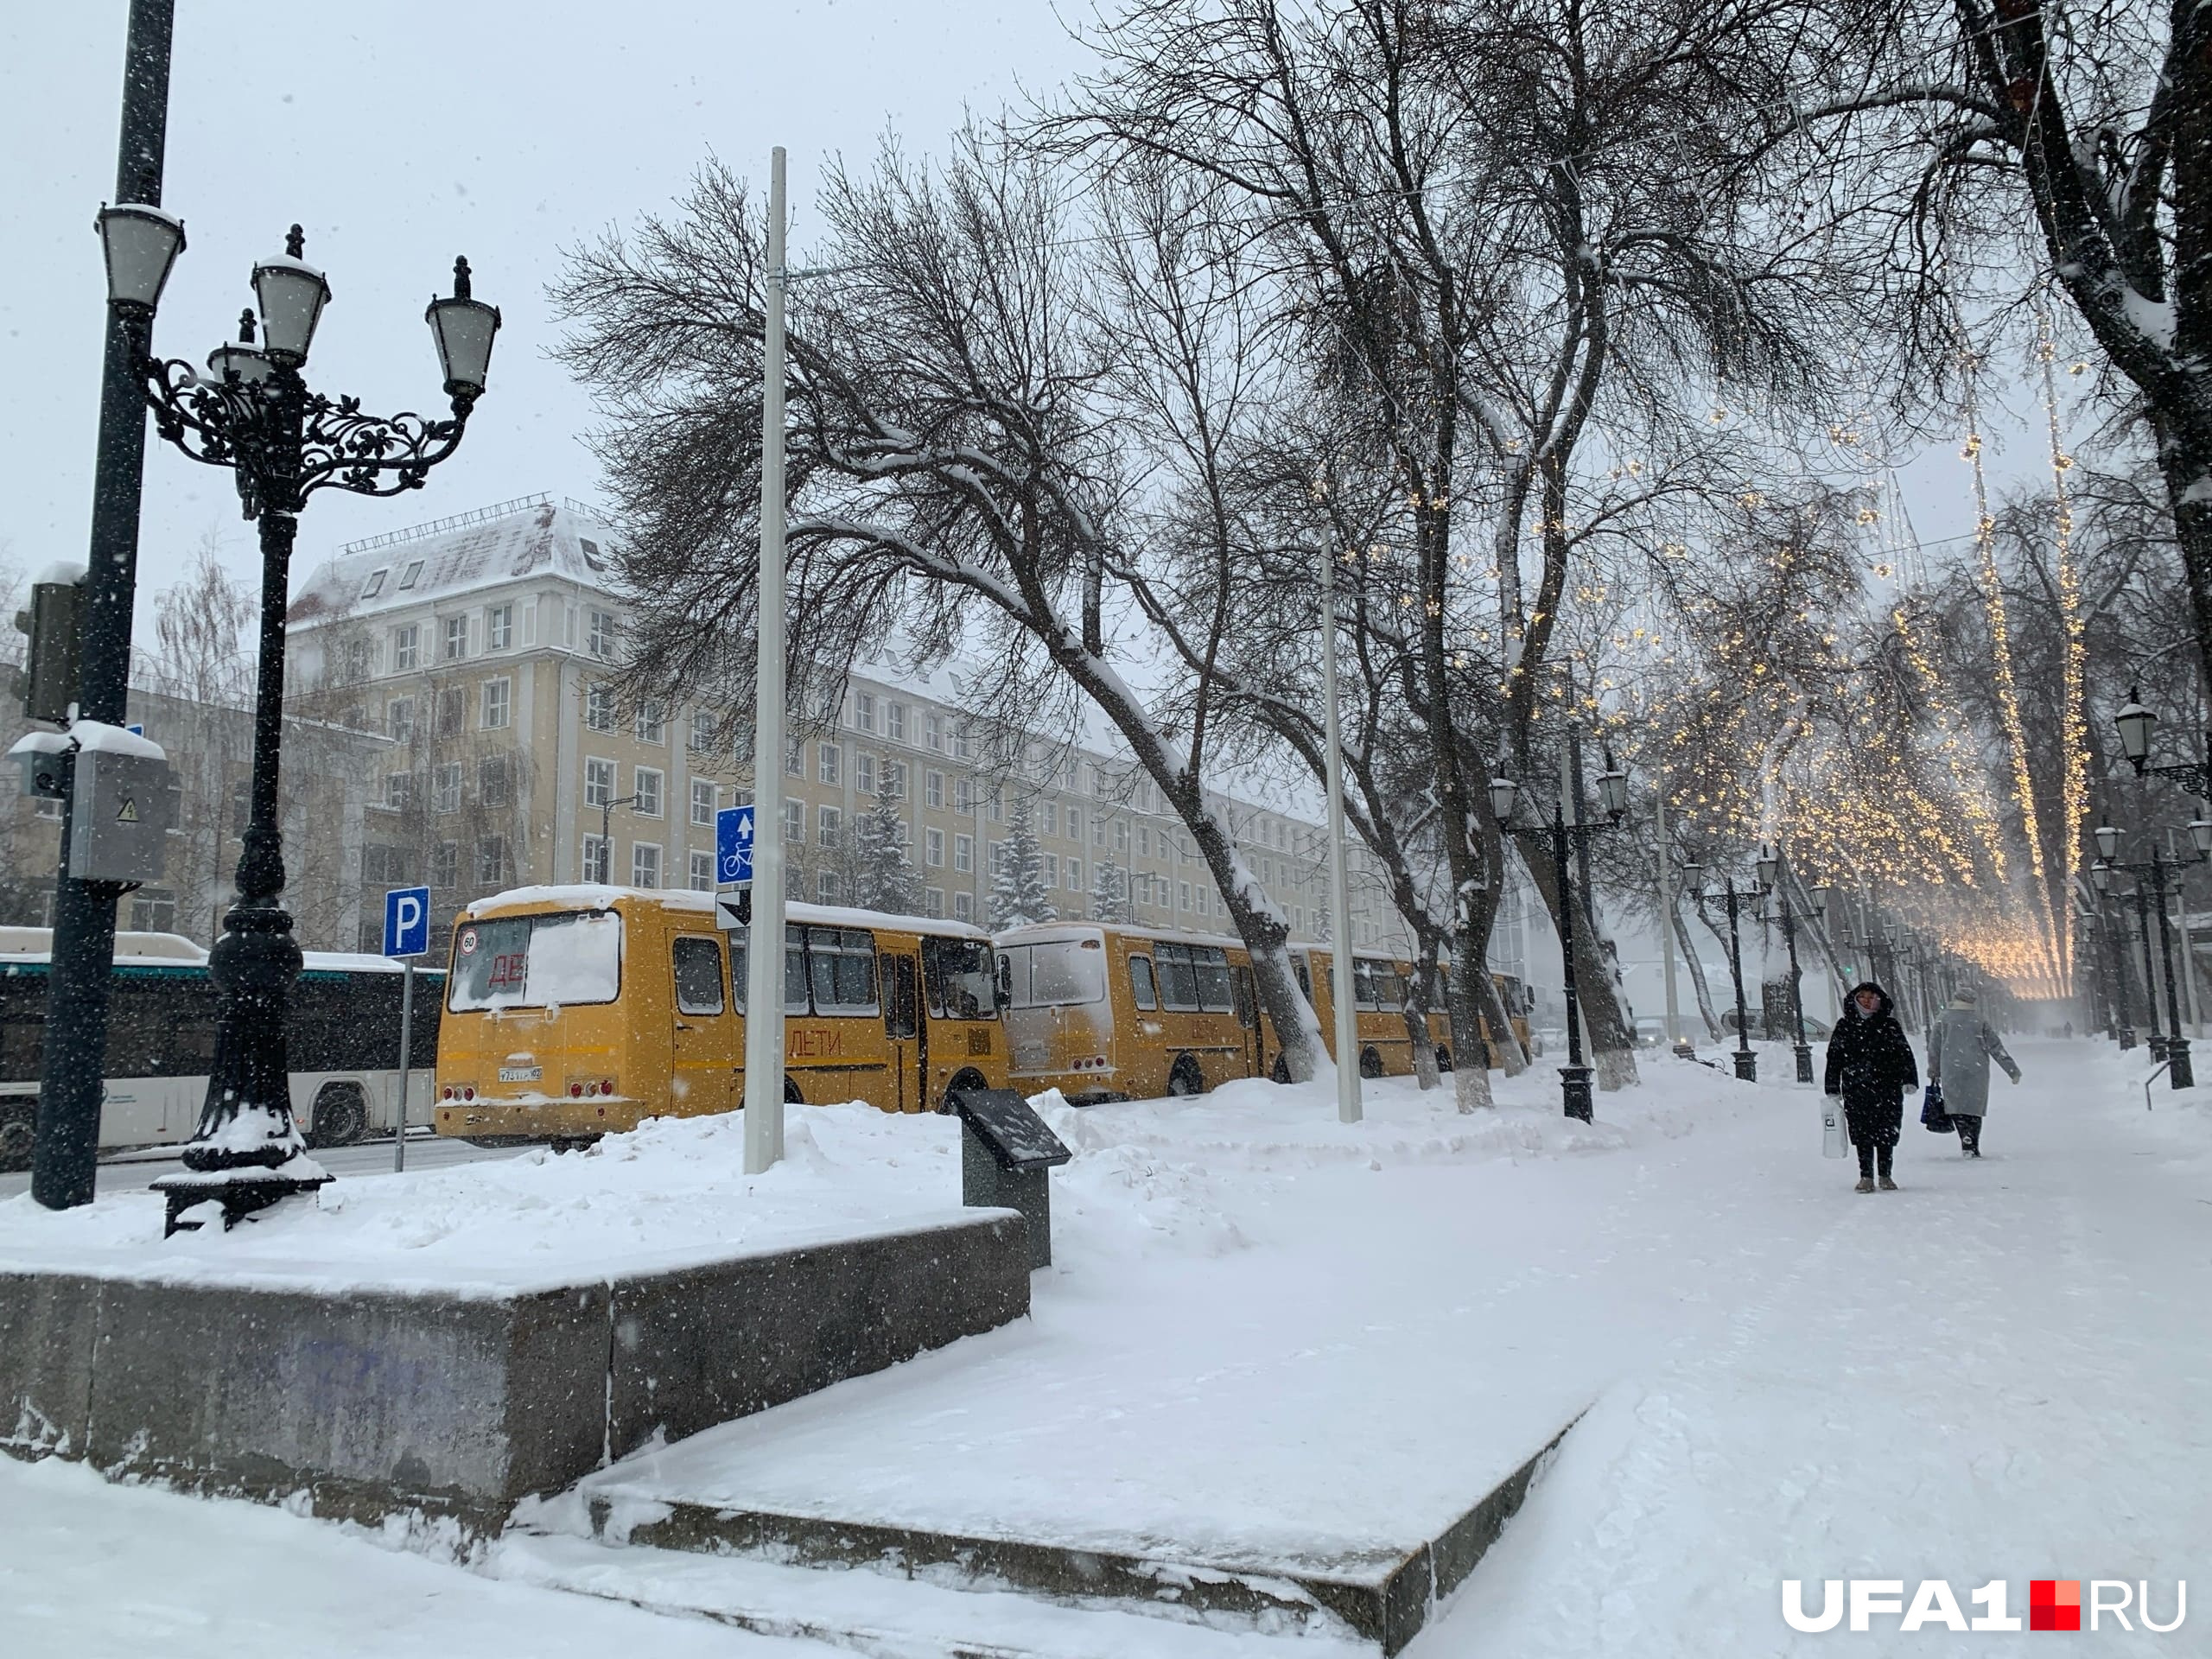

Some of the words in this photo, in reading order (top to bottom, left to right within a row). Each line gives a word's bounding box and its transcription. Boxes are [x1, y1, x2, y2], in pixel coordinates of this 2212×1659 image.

[396, 897, 421, 949] P
[463, 937, 475, 948] 60
[788, 1030, 842, 1057] ДЕТИ
